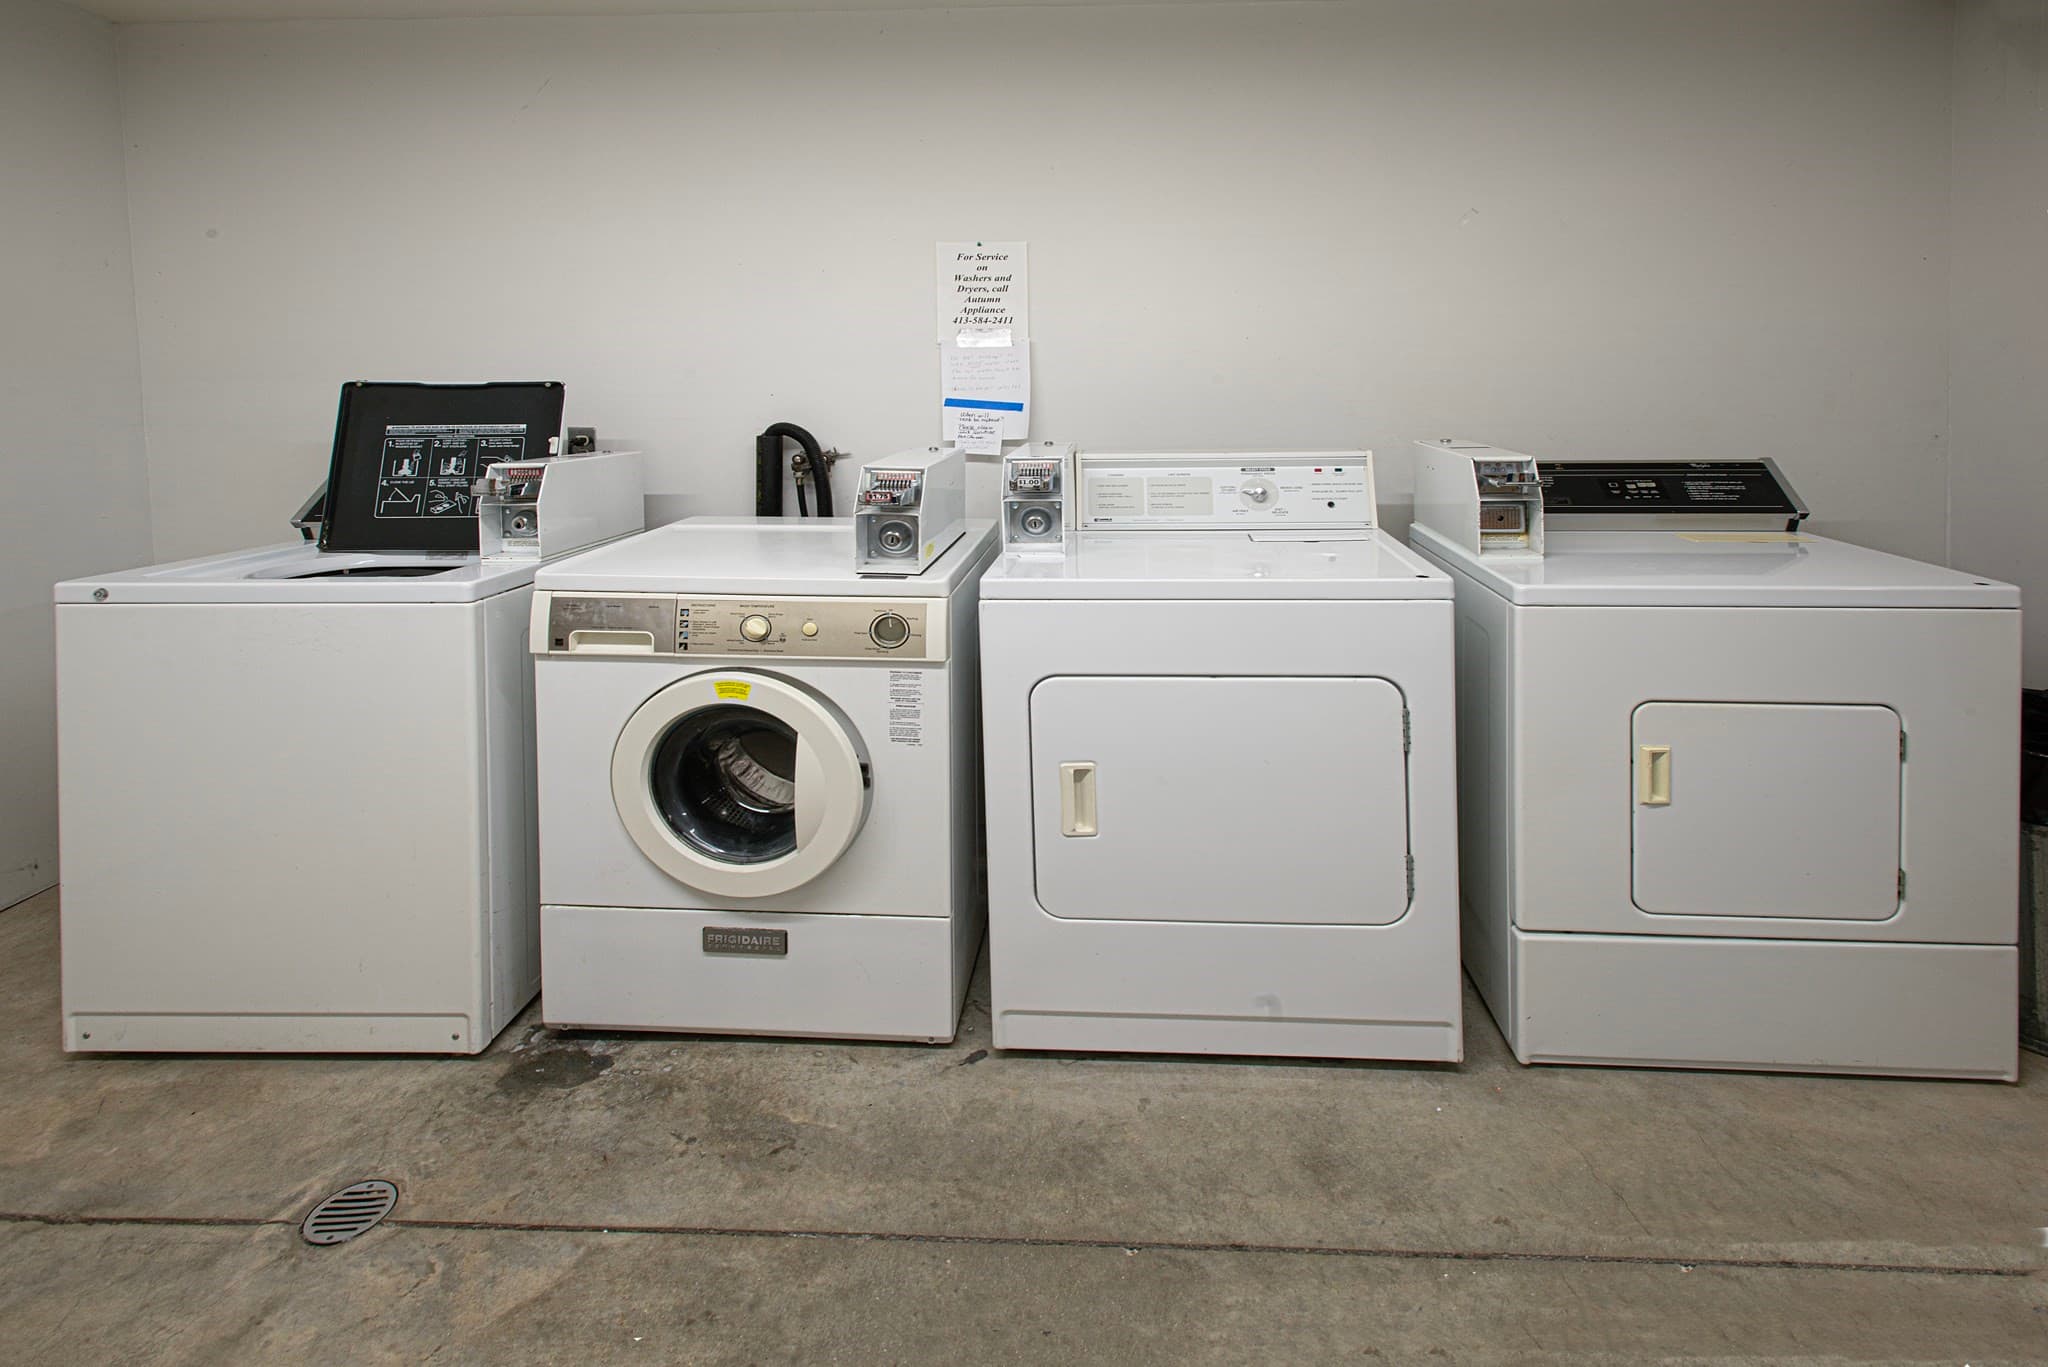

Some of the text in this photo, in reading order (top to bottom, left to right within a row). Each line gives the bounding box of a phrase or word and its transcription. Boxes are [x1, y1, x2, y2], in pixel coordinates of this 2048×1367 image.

[956, 253, 1008, 261] For Service
[954, 274, 1012, 282] Washers and
[957, 285, 990, 294] Dryers,
[960, 306, 1006, 315] Appliance
[952, 316, 1014, 324] 413-584-2411
[707, 934, 781, 946] FRIGIDAIRE
